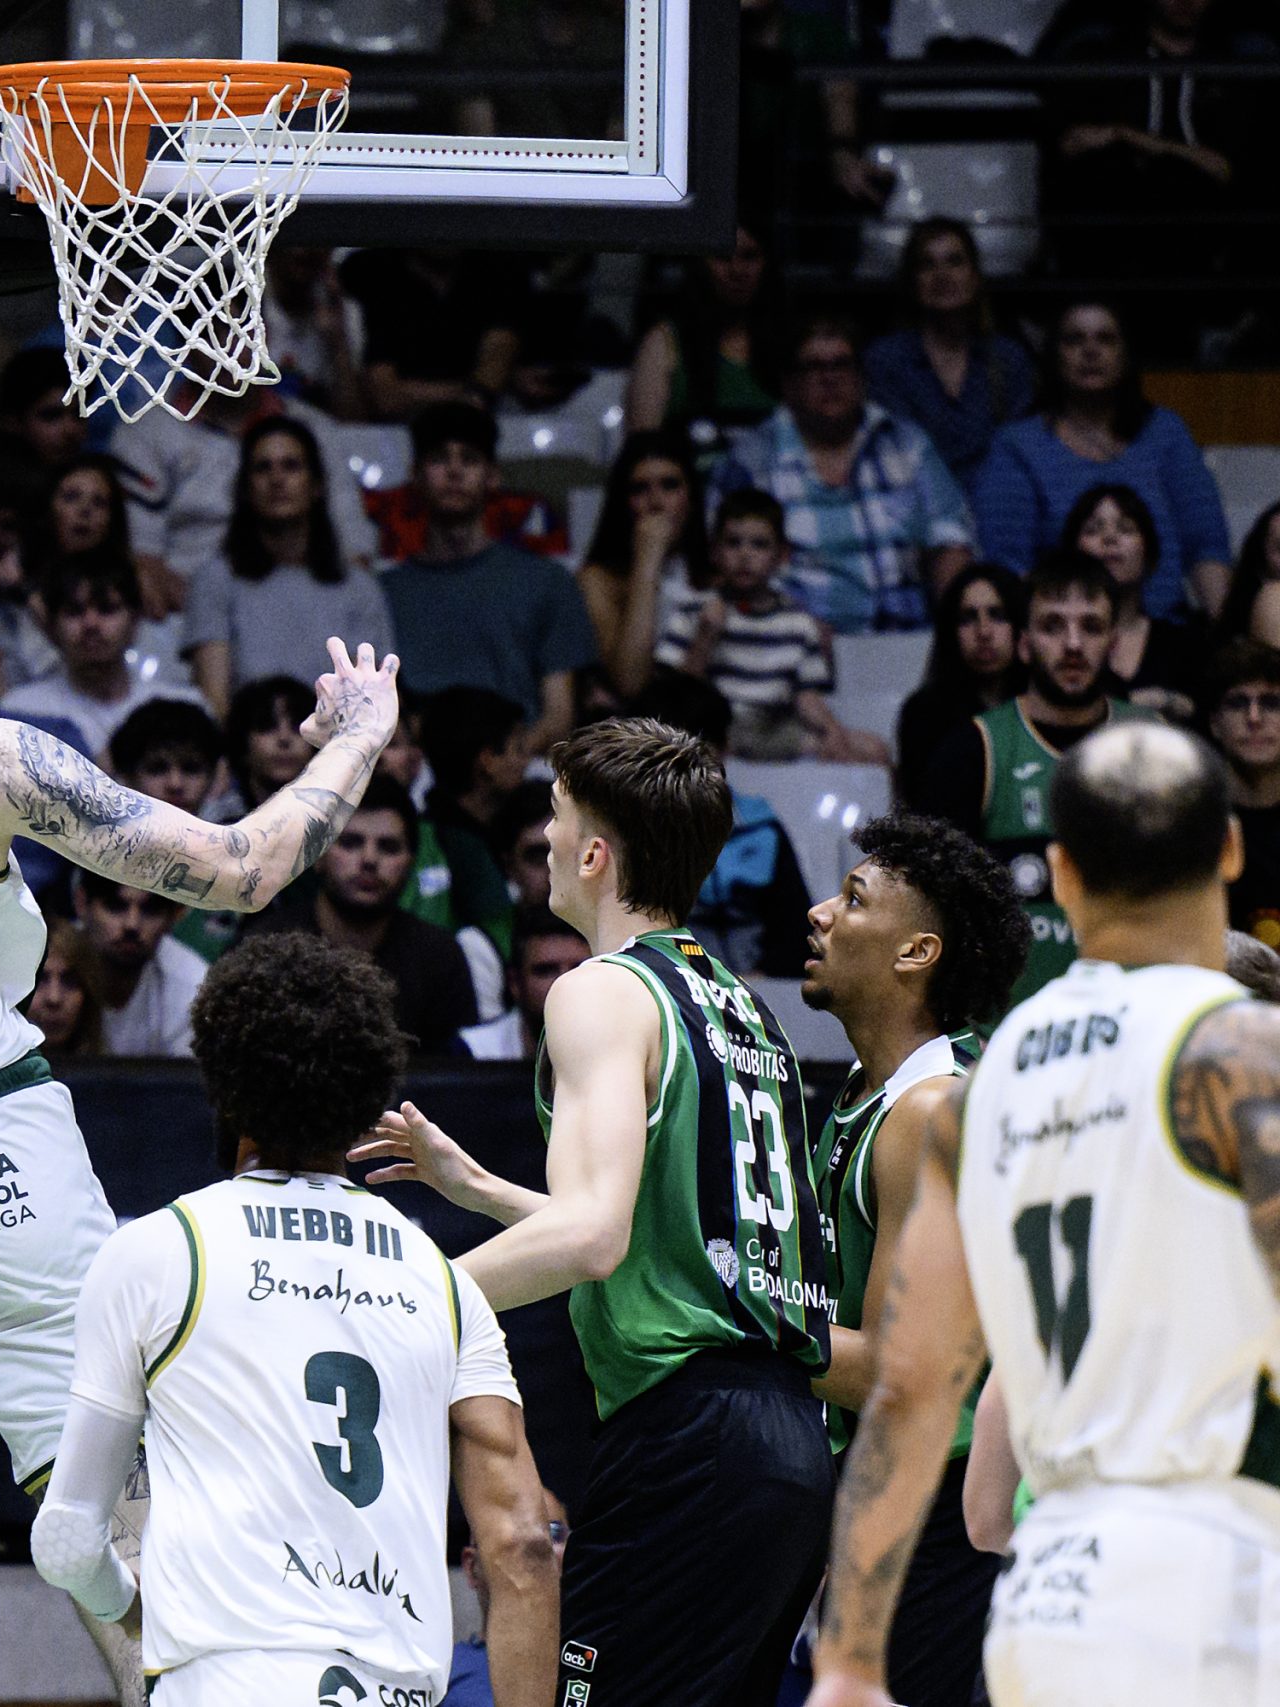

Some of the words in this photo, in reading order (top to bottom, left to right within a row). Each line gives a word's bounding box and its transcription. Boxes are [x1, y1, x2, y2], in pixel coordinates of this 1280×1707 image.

[727, 1041, 789, 1082] PROBITAS
[728, 1080, 794, 1232] 23
[241, 1204, 354, 1248] WEBB
[365, 1219, 403, 1262] III
[768, 1246, 780, 1268] of
[748, 1266, 828, 1311] BDALONA
[304, 1350, 385, 1509] 3
[564, 1652, 586, 1667] acb
